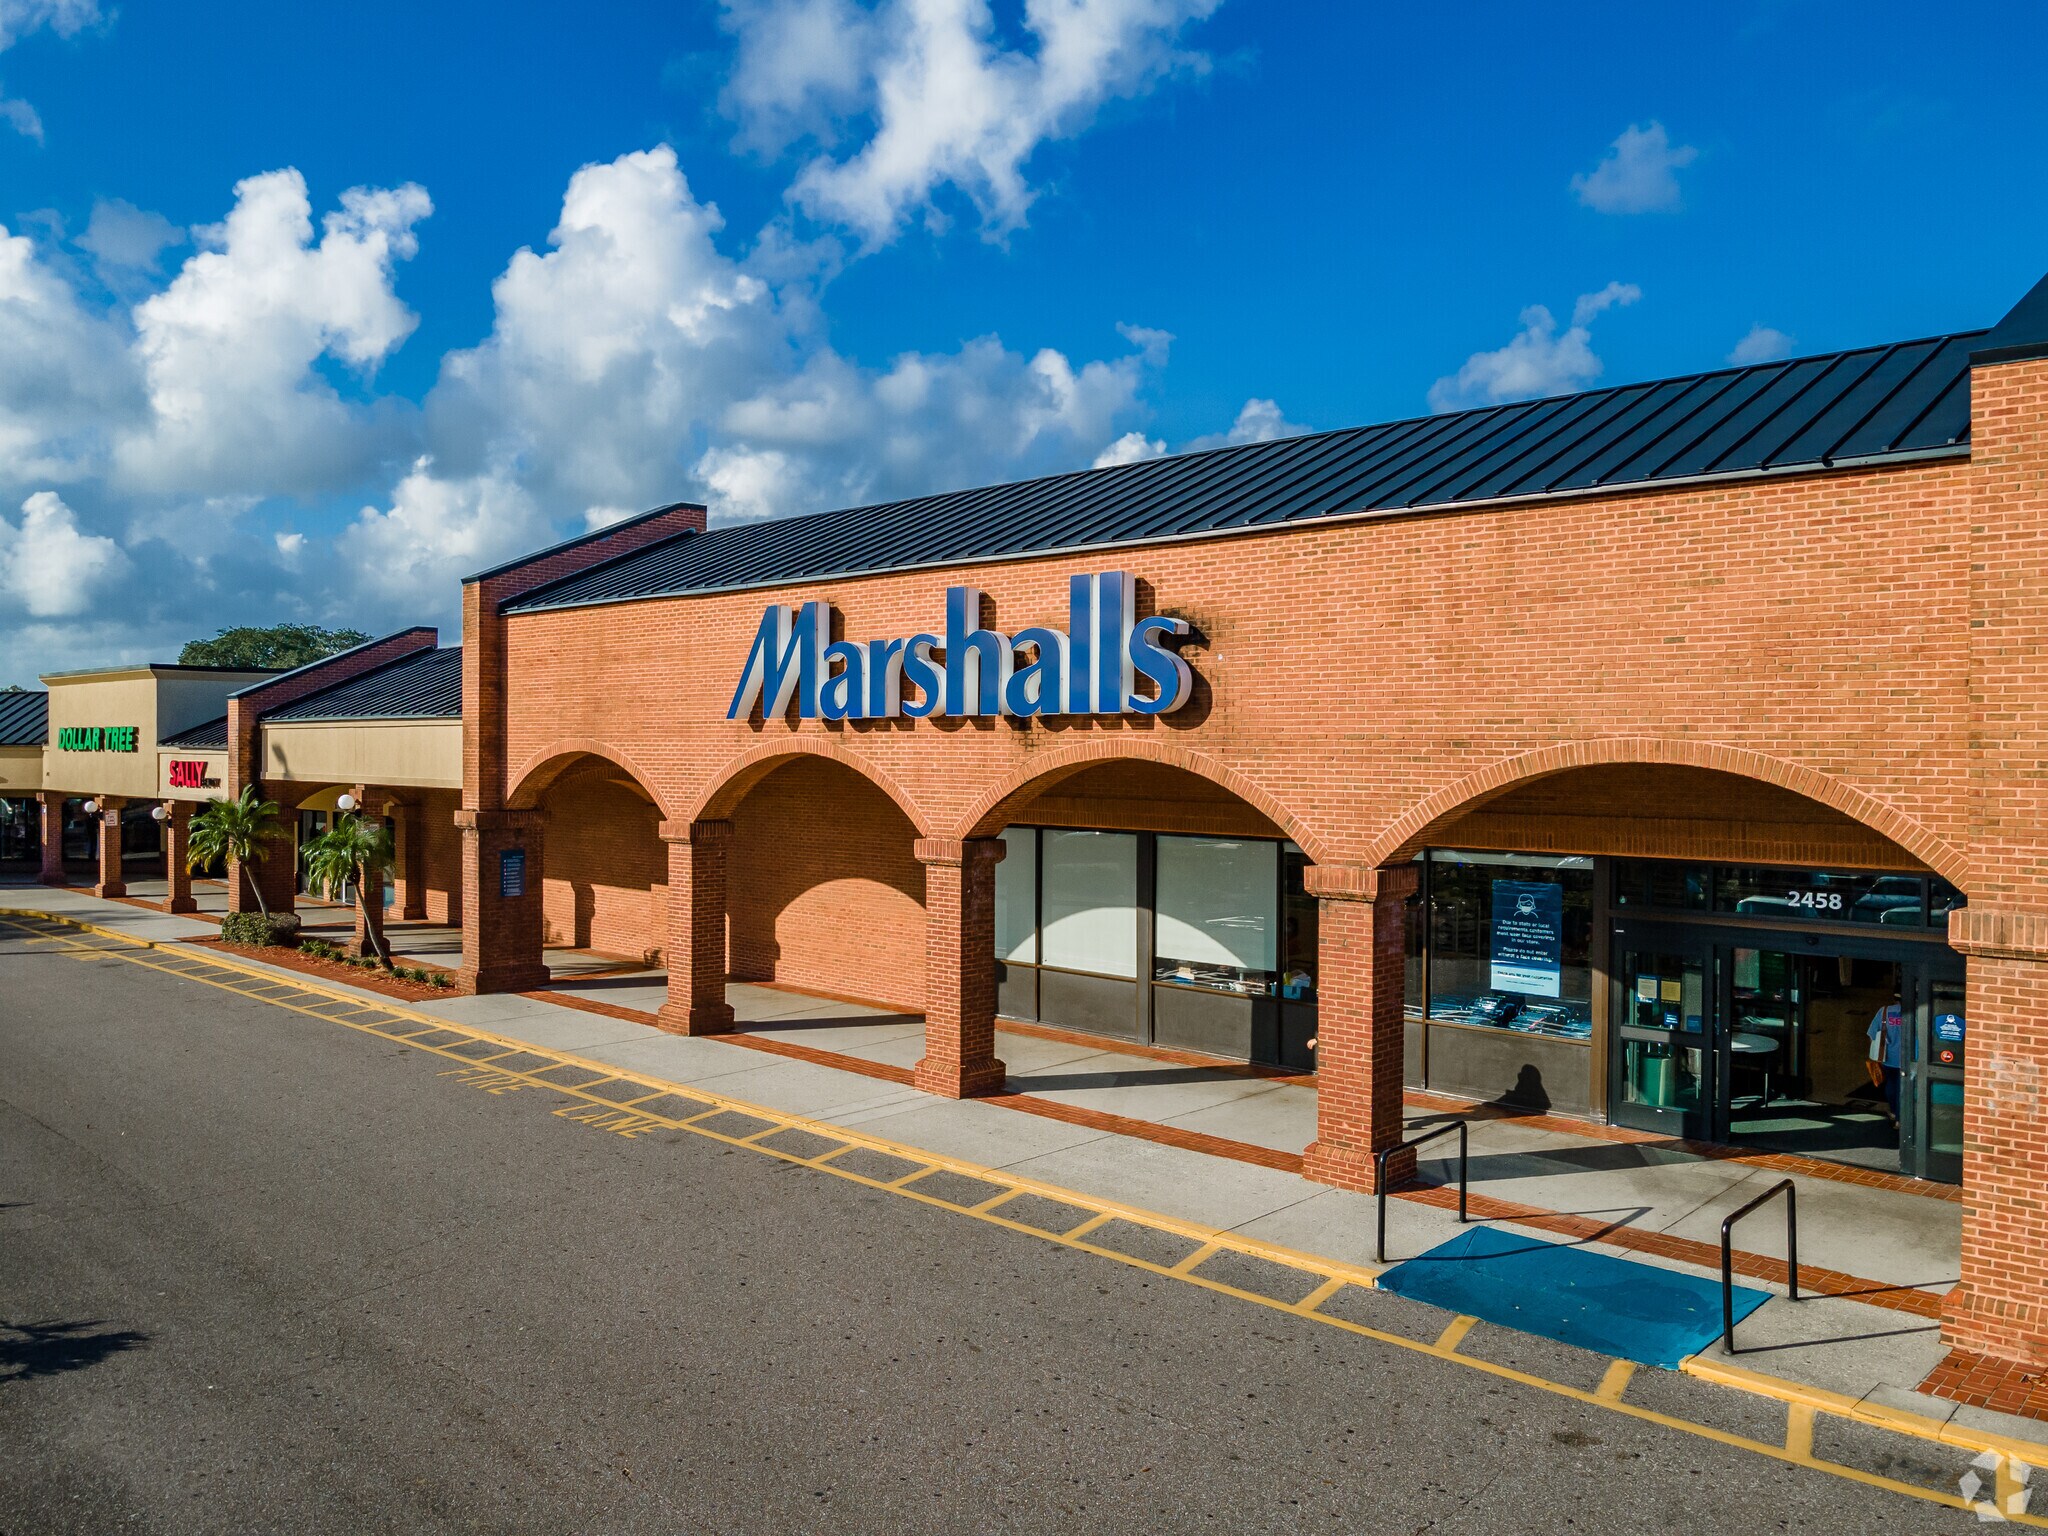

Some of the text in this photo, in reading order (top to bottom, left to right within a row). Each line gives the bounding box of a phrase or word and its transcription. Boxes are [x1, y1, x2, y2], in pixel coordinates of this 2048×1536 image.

[727, 570, 1193, 720] Marshalls
[58, 726, 134, 751] DOLLAR TREE
[169, 760, 205, 787] SALLY
[1788, 891, 1842, 910] 2458
[436, 1067, 544, 1095] FIRE
[551, 1103, 679, 1139] LANE
